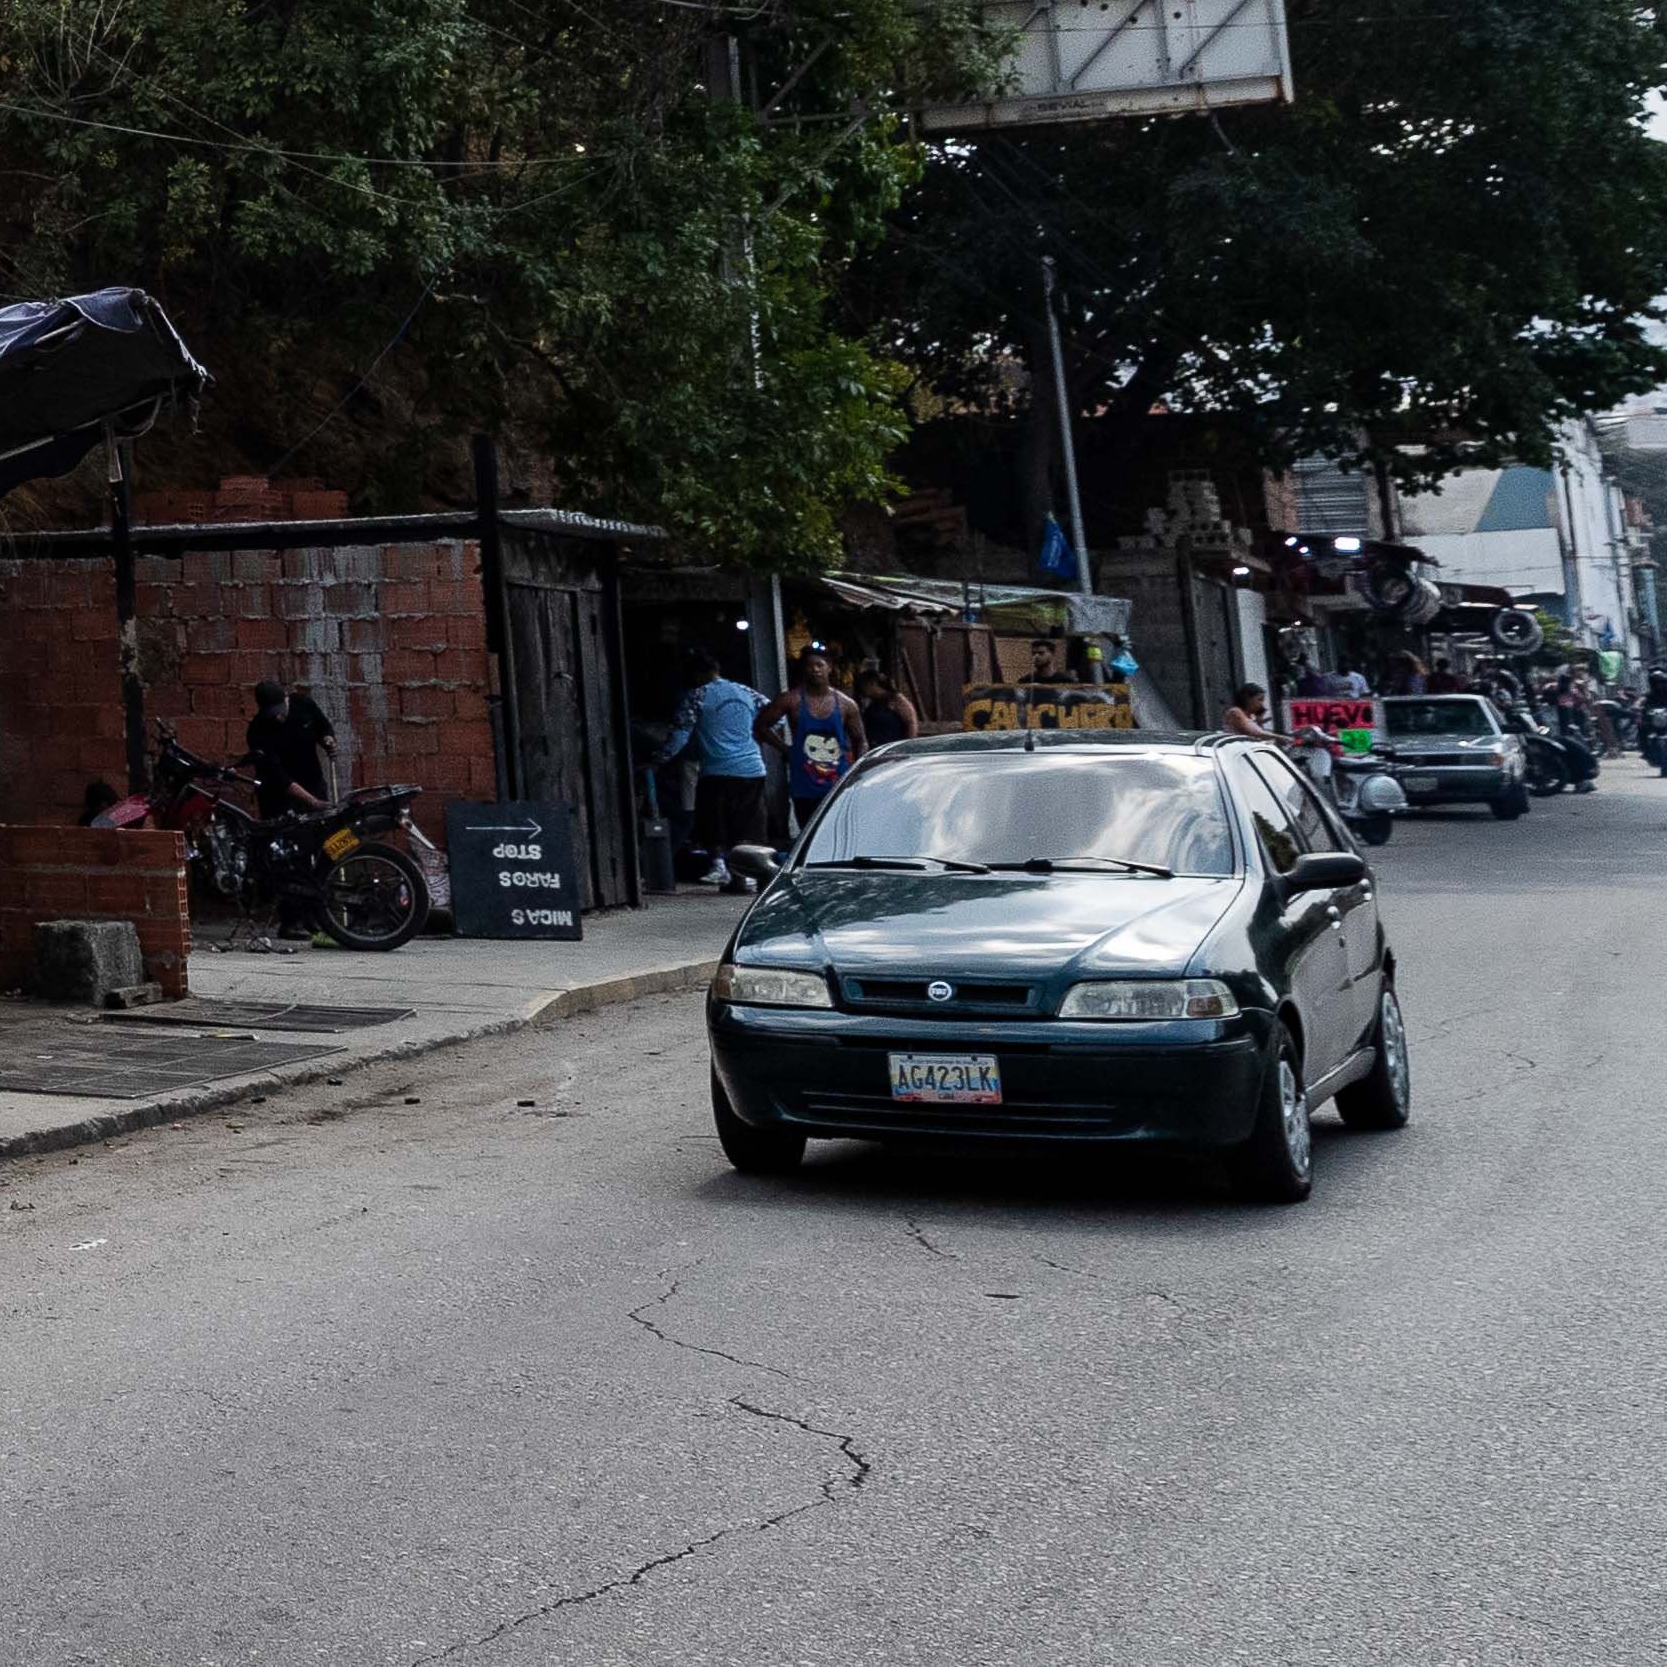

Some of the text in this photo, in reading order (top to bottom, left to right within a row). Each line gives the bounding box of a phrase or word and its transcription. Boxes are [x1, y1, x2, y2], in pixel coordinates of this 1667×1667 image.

[492, 843, 542, 860] STOP
[498, 871, 561, 889] FAROS
[897, 1065, 993, 1092] AG423LK
